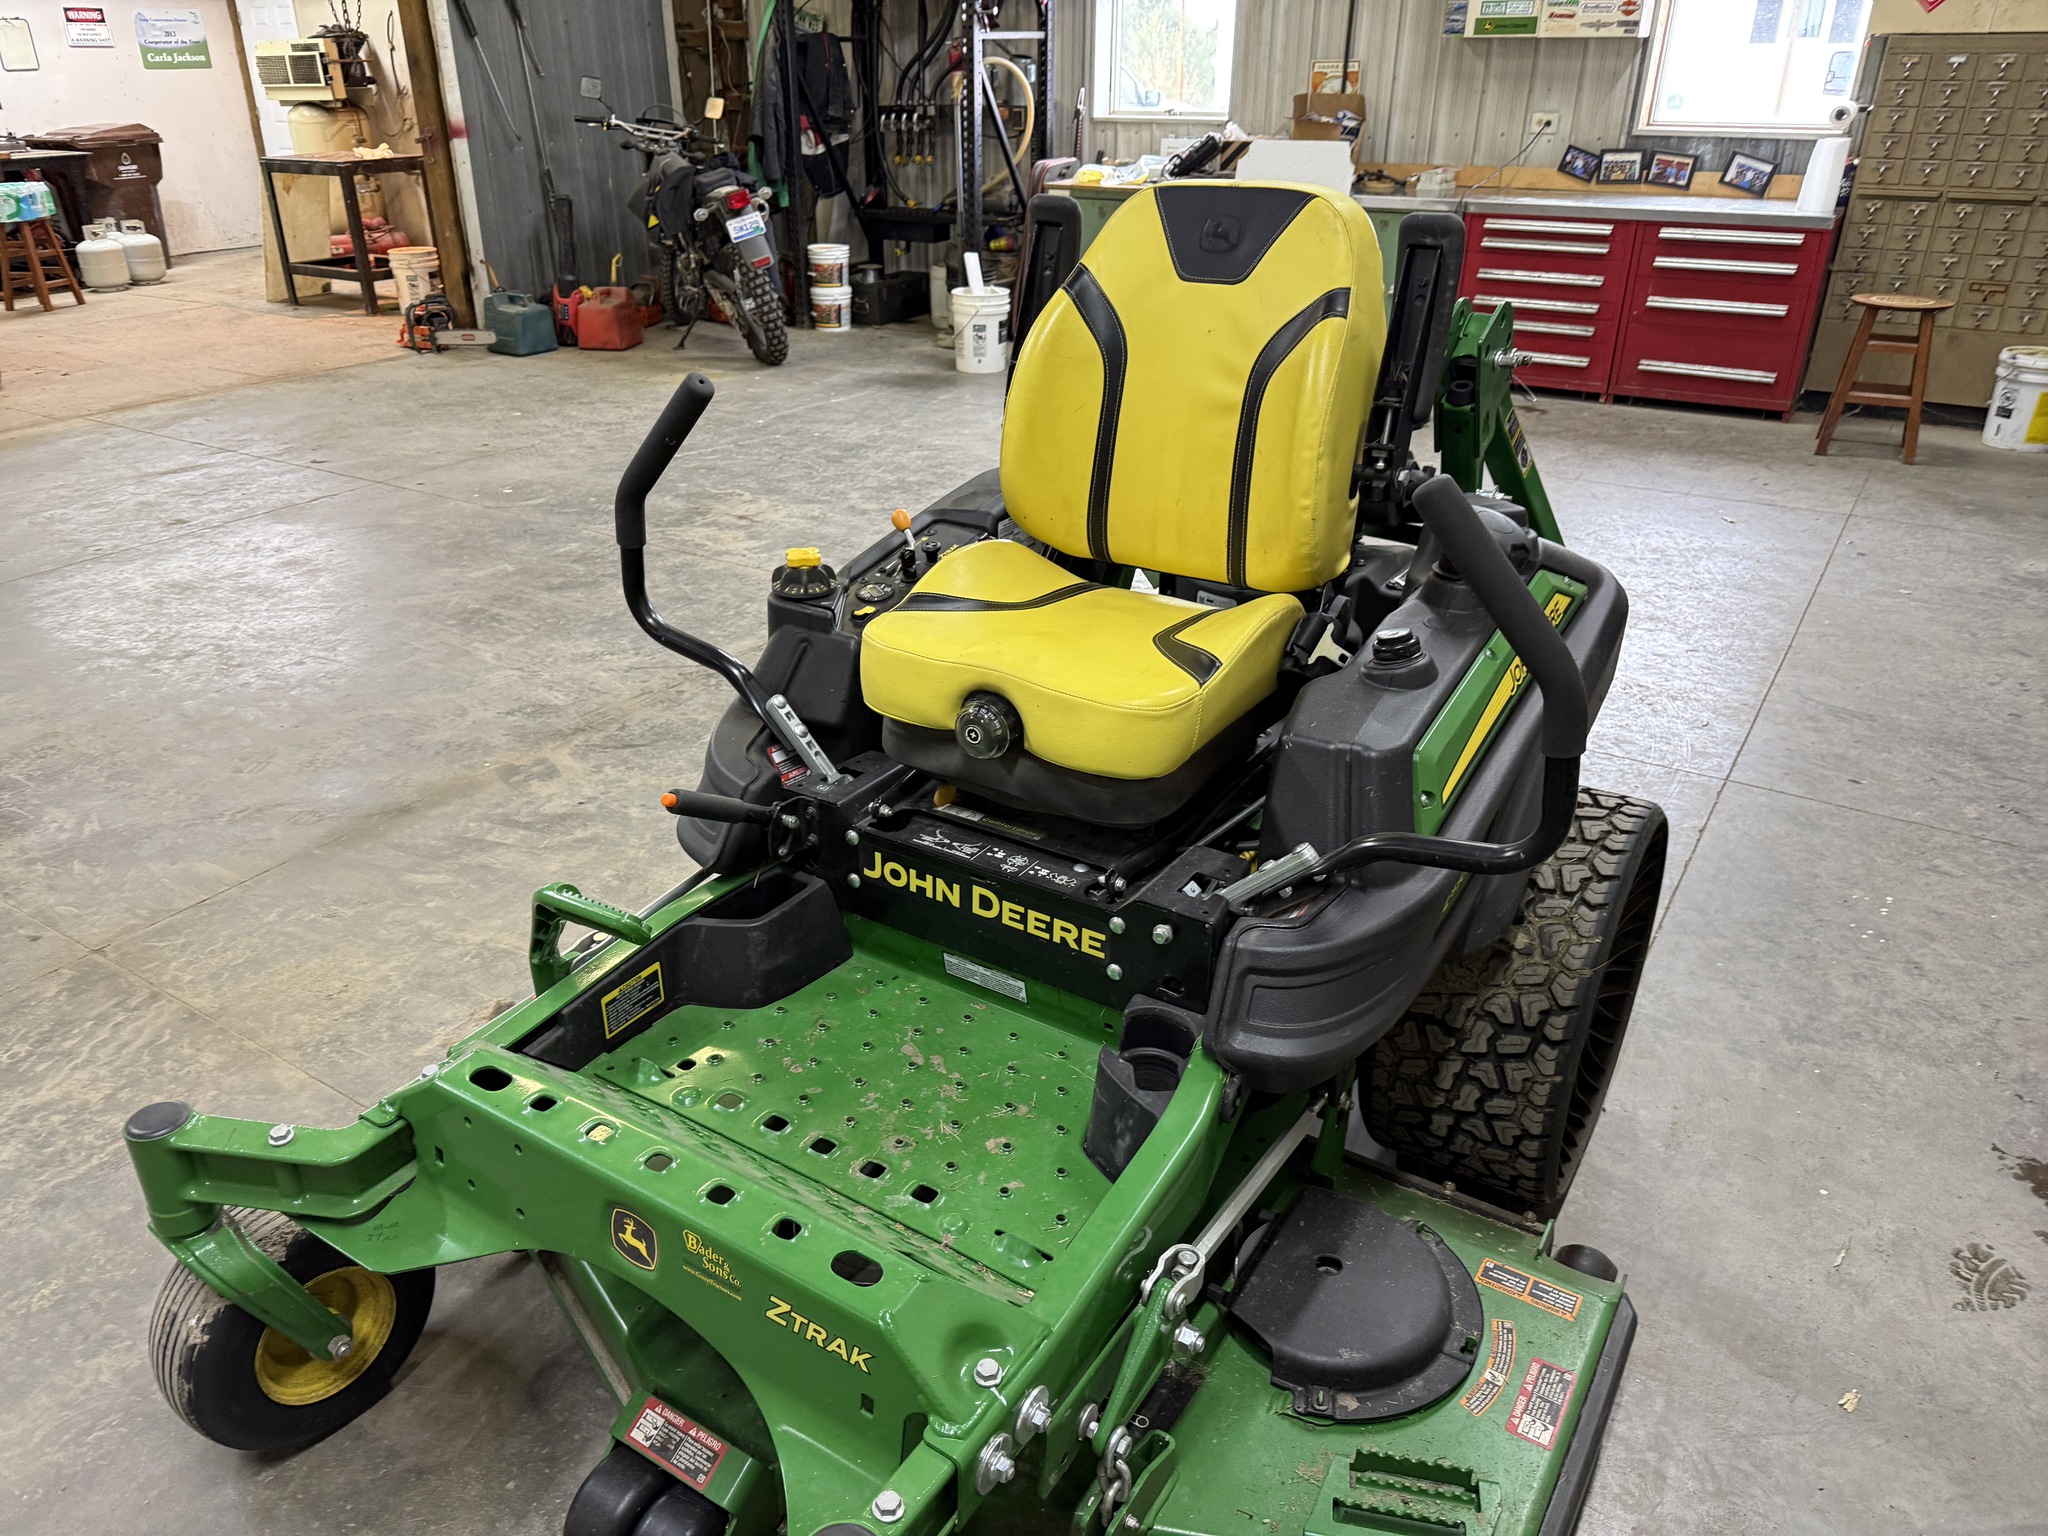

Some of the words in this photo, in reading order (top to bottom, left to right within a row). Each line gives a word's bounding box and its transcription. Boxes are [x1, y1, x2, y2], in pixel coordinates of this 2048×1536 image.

[66, 10, 103, 20] WARNING
[147, 52, 172, 62] Carla
[173, 52, 206, 63] Jackson
[863, 851, 960, 908] JOHN
[972, 884, 1106, 959] DEERE
[686, 1232, 724, 1265] Bader
[702, 1256, 728, 1280] Sons
[1530, 1298, 1562, 1315] WARNING
[764, 1294, 876, 1375] ZTRAK
[1512, 1395, 1528, 1417] DANGER
[661, 1407, 686, 1428] DANGER
[696, 1430, 722, 1451] PELIGRO
